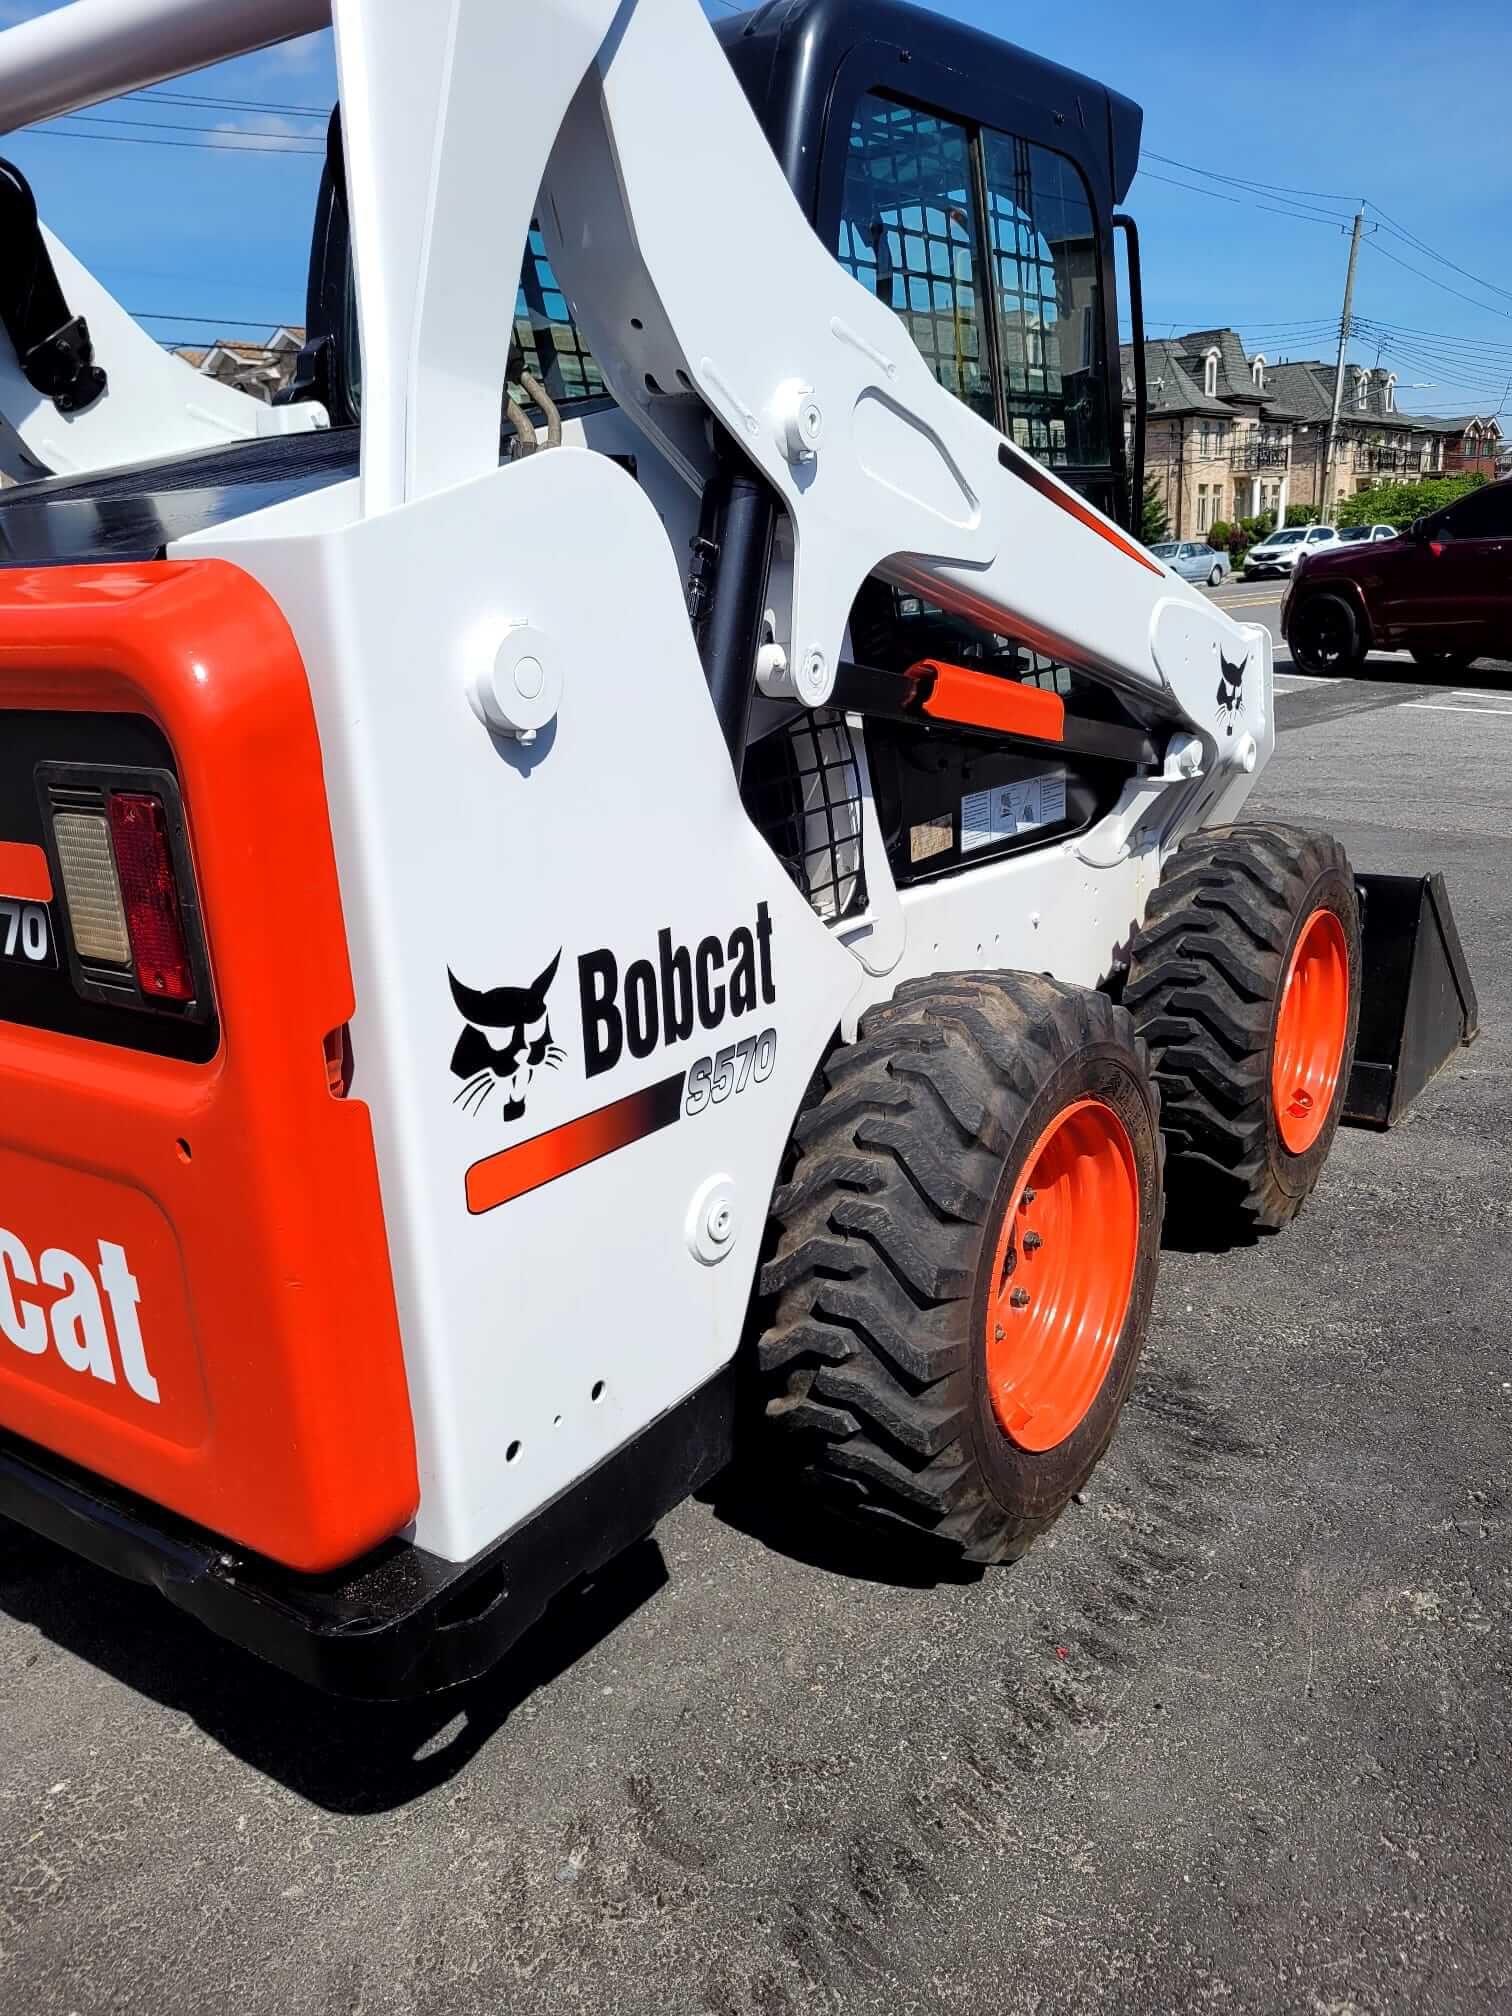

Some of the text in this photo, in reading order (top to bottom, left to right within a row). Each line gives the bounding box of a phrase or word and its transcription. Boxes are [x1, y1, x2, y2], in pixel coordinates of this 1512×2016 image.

[577, 901, 776, 1079] Bobcat
[686, 1027, 776, 1116] S570
[0, 1227, 160, 1404] cat
